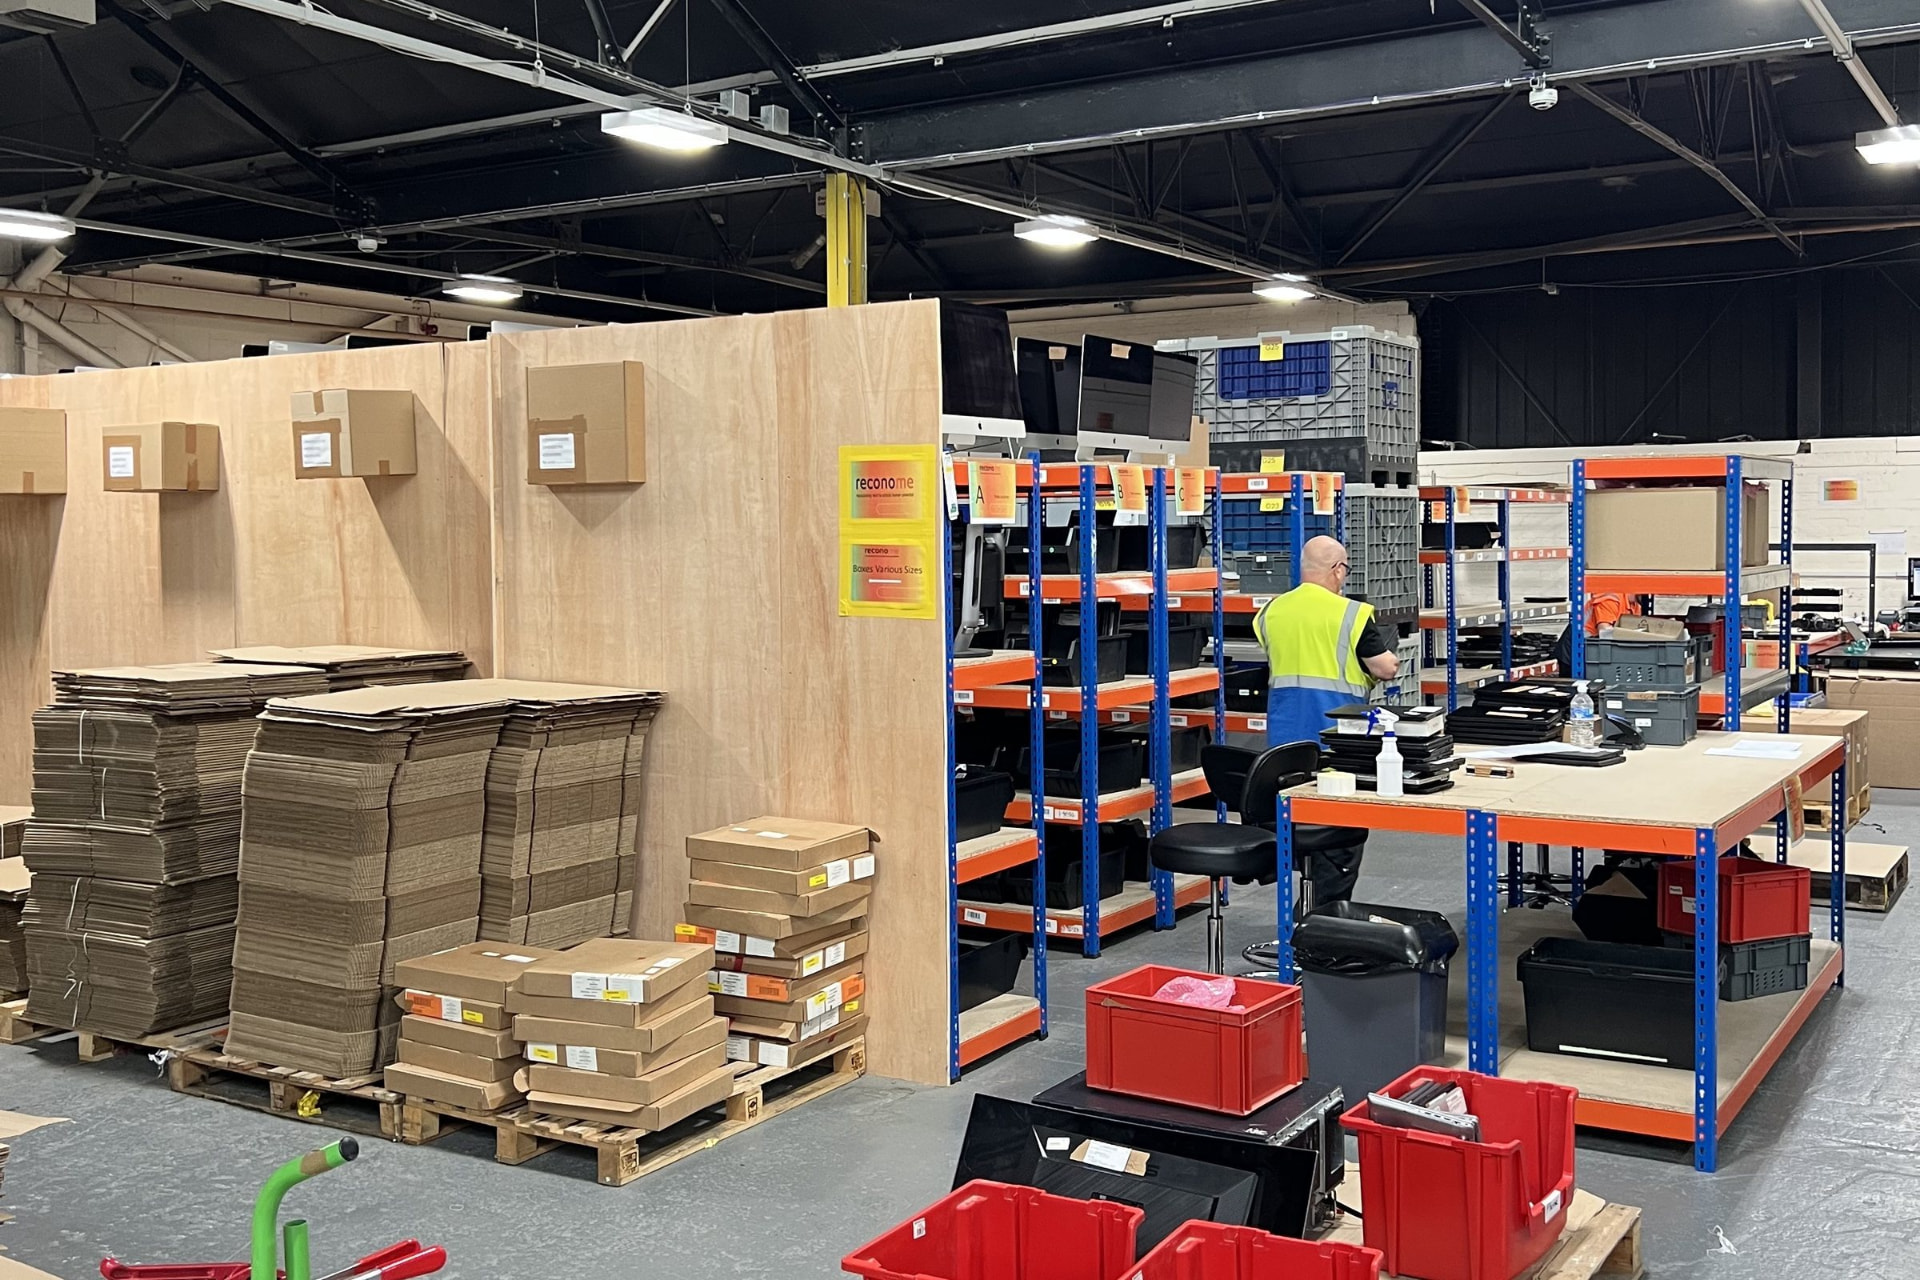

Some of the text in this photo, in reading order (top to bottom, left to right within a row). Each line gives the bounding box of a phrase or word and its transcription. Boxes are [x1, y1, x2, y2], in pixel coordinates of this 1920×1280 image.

[855, 477, 914, 490] reconome
[976, 485, 985, 504] A
[1117, 484, 1124, 499] B
[1178, 487, 1185, 501] C
[852, 564, 923, 575] Boxes Various Sizes
